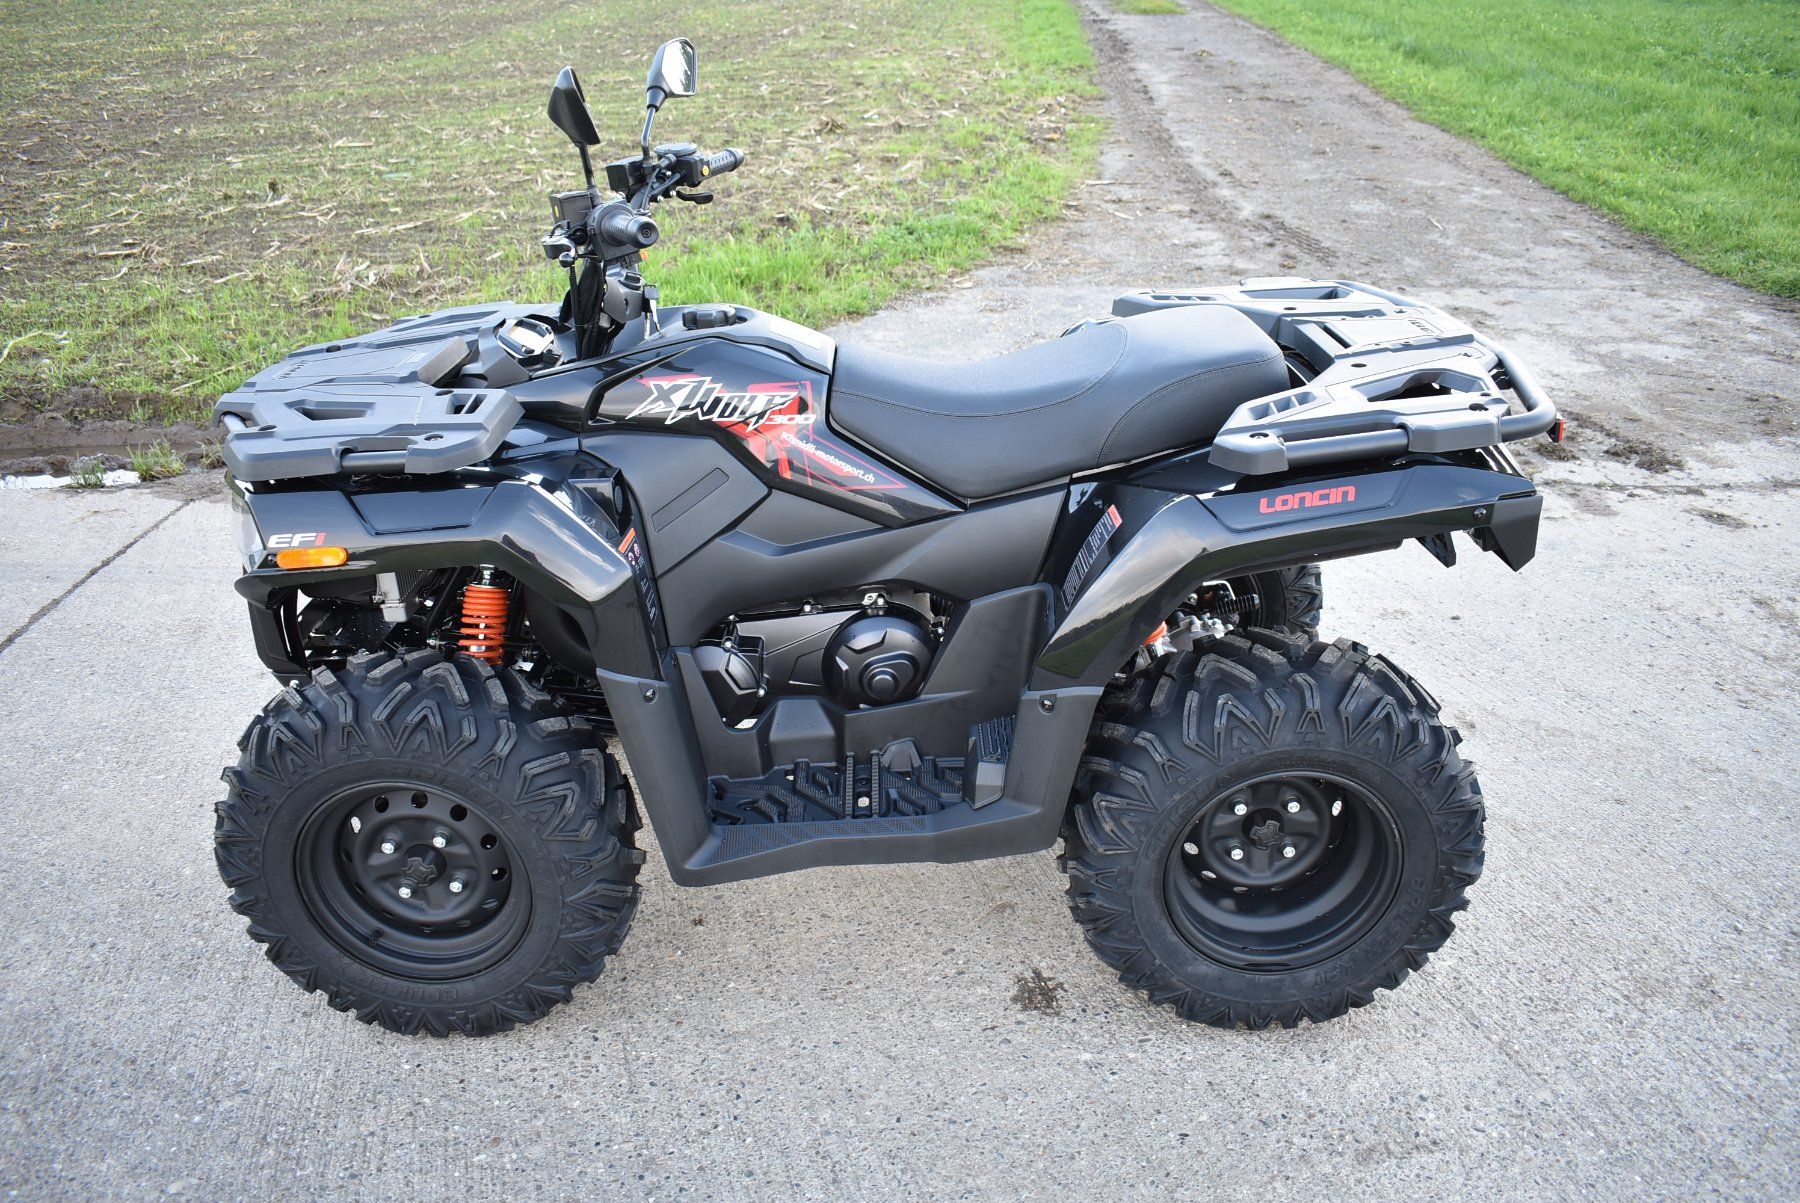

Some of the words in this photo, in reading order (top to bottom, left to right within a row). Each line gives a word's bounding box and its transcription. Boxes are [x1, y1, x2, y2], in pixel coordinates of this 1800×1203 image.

[765, 414, 817, 425] 300
[780, 431, 875, 484] schmidli-motorsport.ch
[1259, 485, 1356, 514] LONCIN
